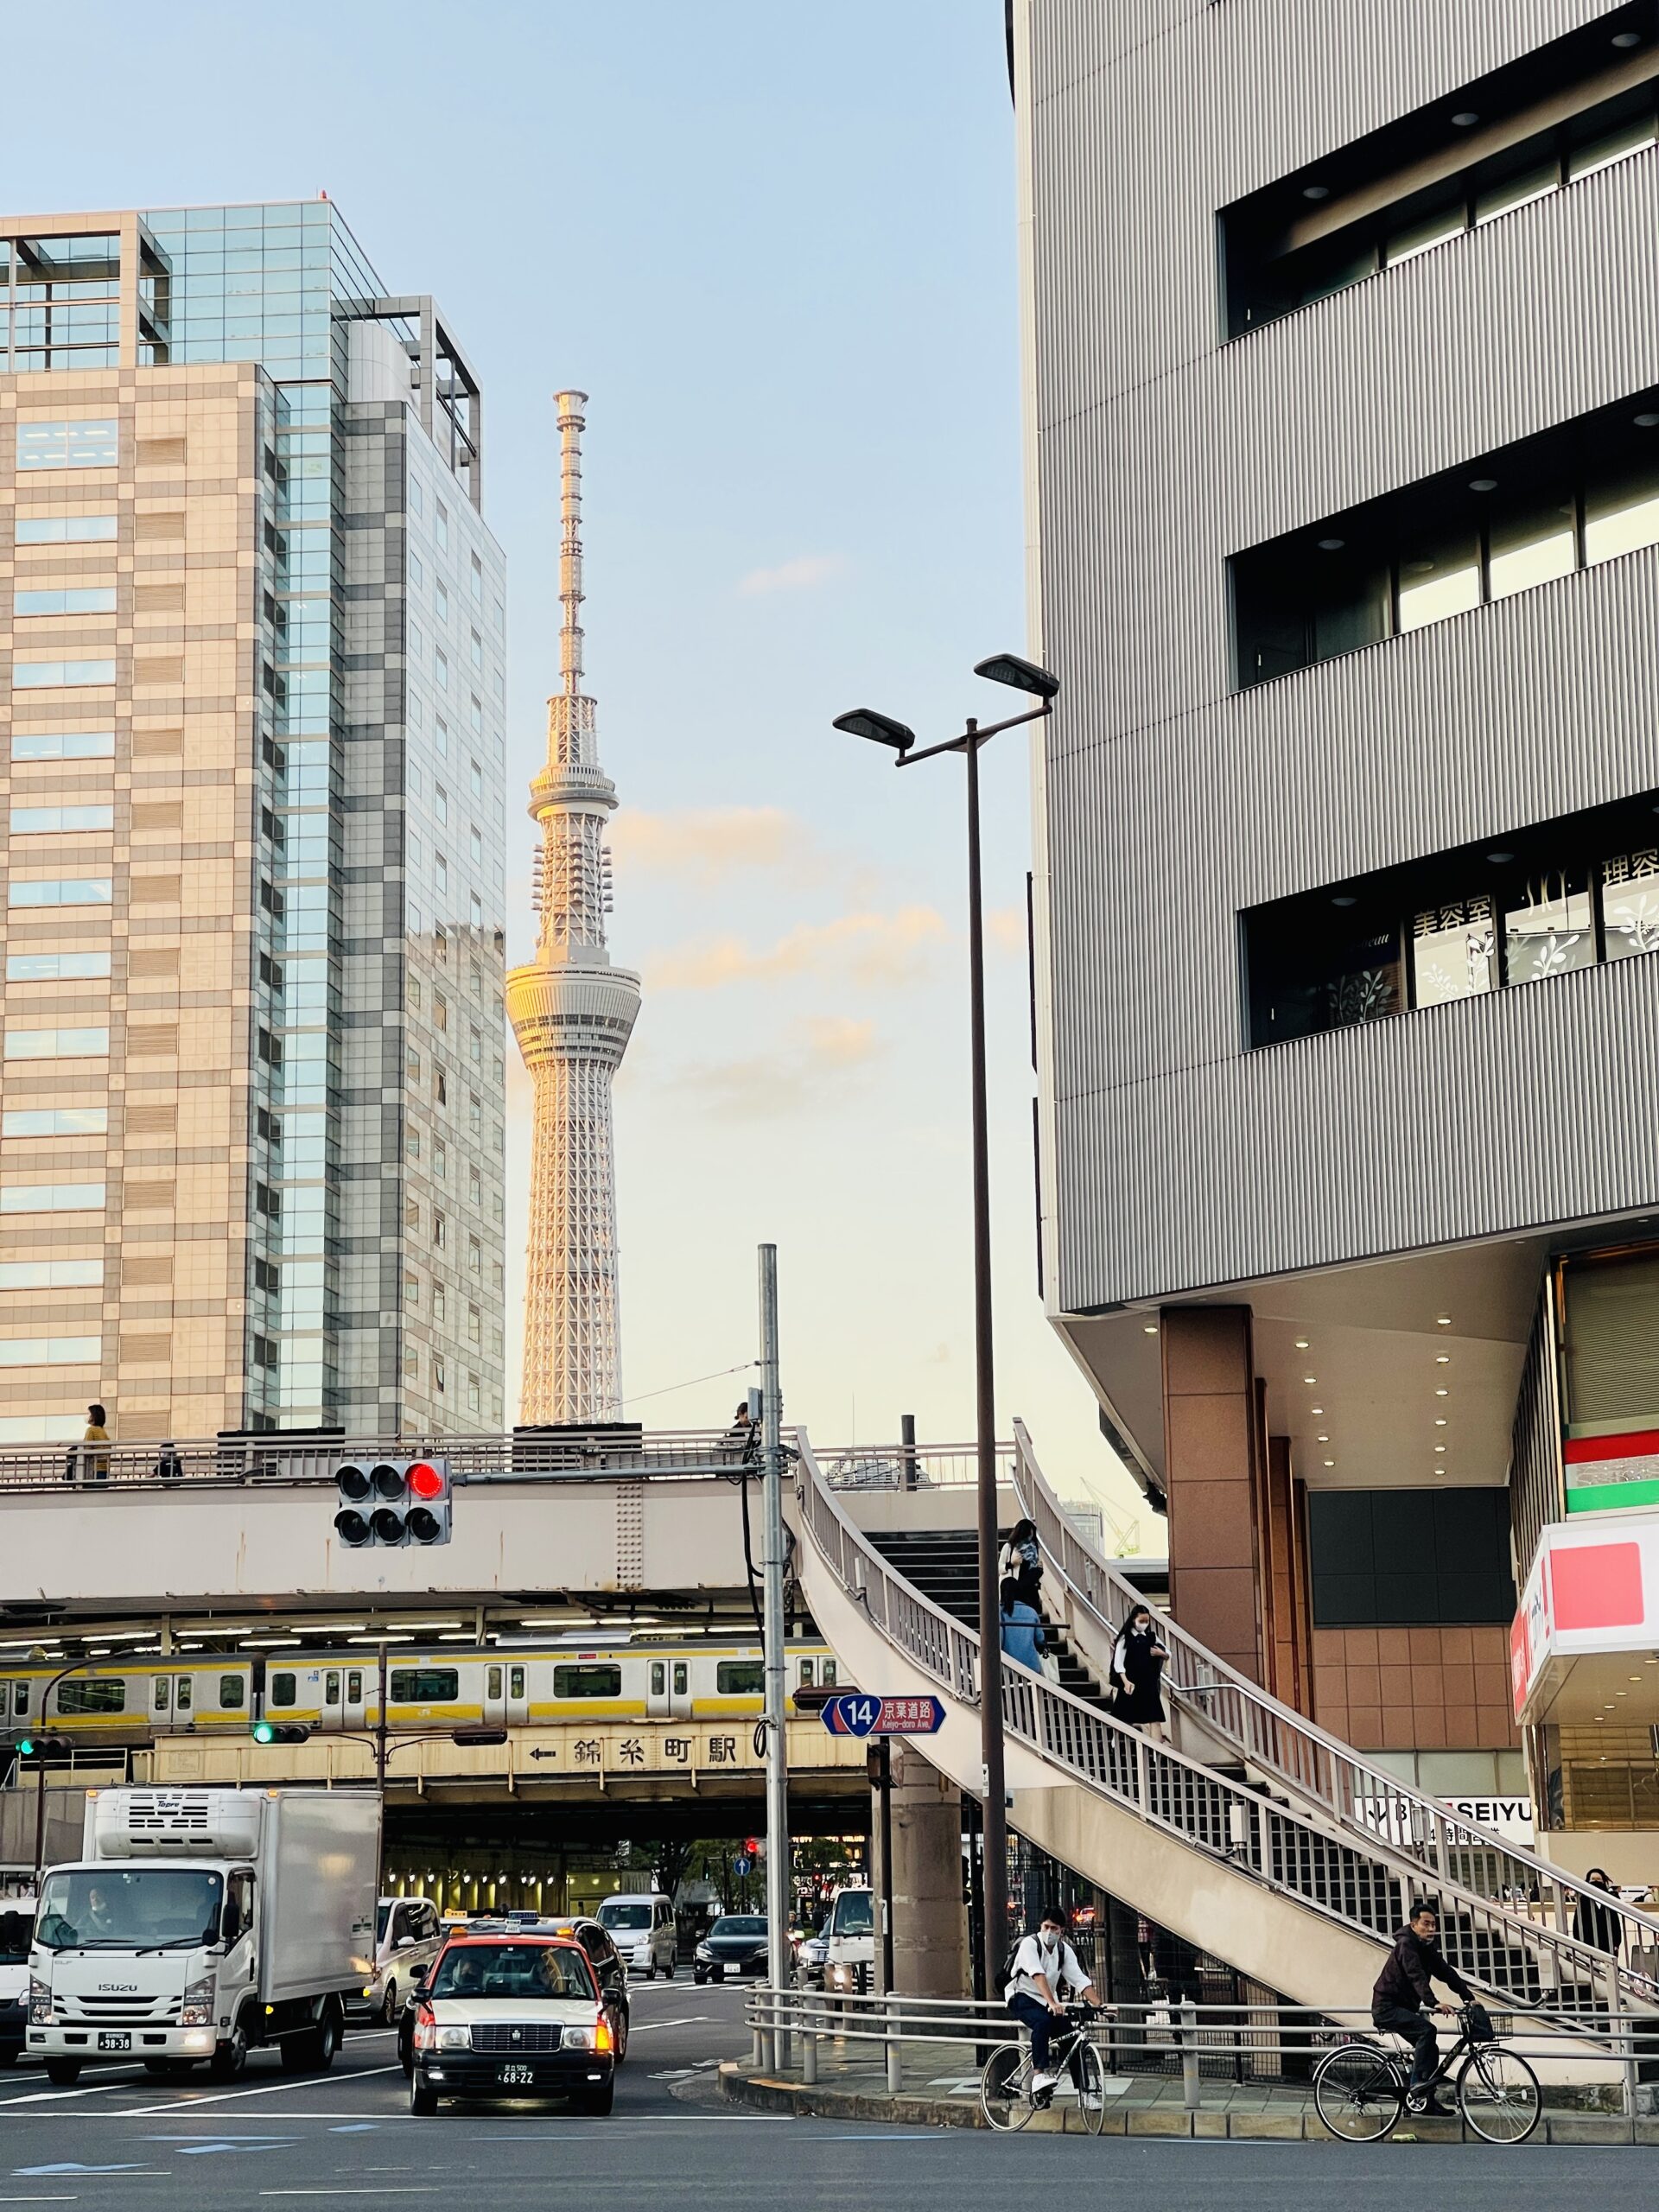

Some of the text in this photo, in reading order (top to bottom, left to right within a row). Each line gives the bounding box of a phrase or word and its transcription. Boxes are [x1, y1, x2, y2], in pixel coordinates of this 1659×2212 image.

[1414, 894, 1491, 939] 美容室
[847, 1700, 873, 1726] 14
[884, 1701, 931, 1719] 京葉道路
[882, 1719, 916, 1731] Keiyo-doro
[574, 1737, 736, 1765] 錦糸町駅
[1457, 1802, 1532, 1821] SEIYU
[105, 2039, 130, 2049] 98-38
[503, 2072, 533, 2083] 68-22
